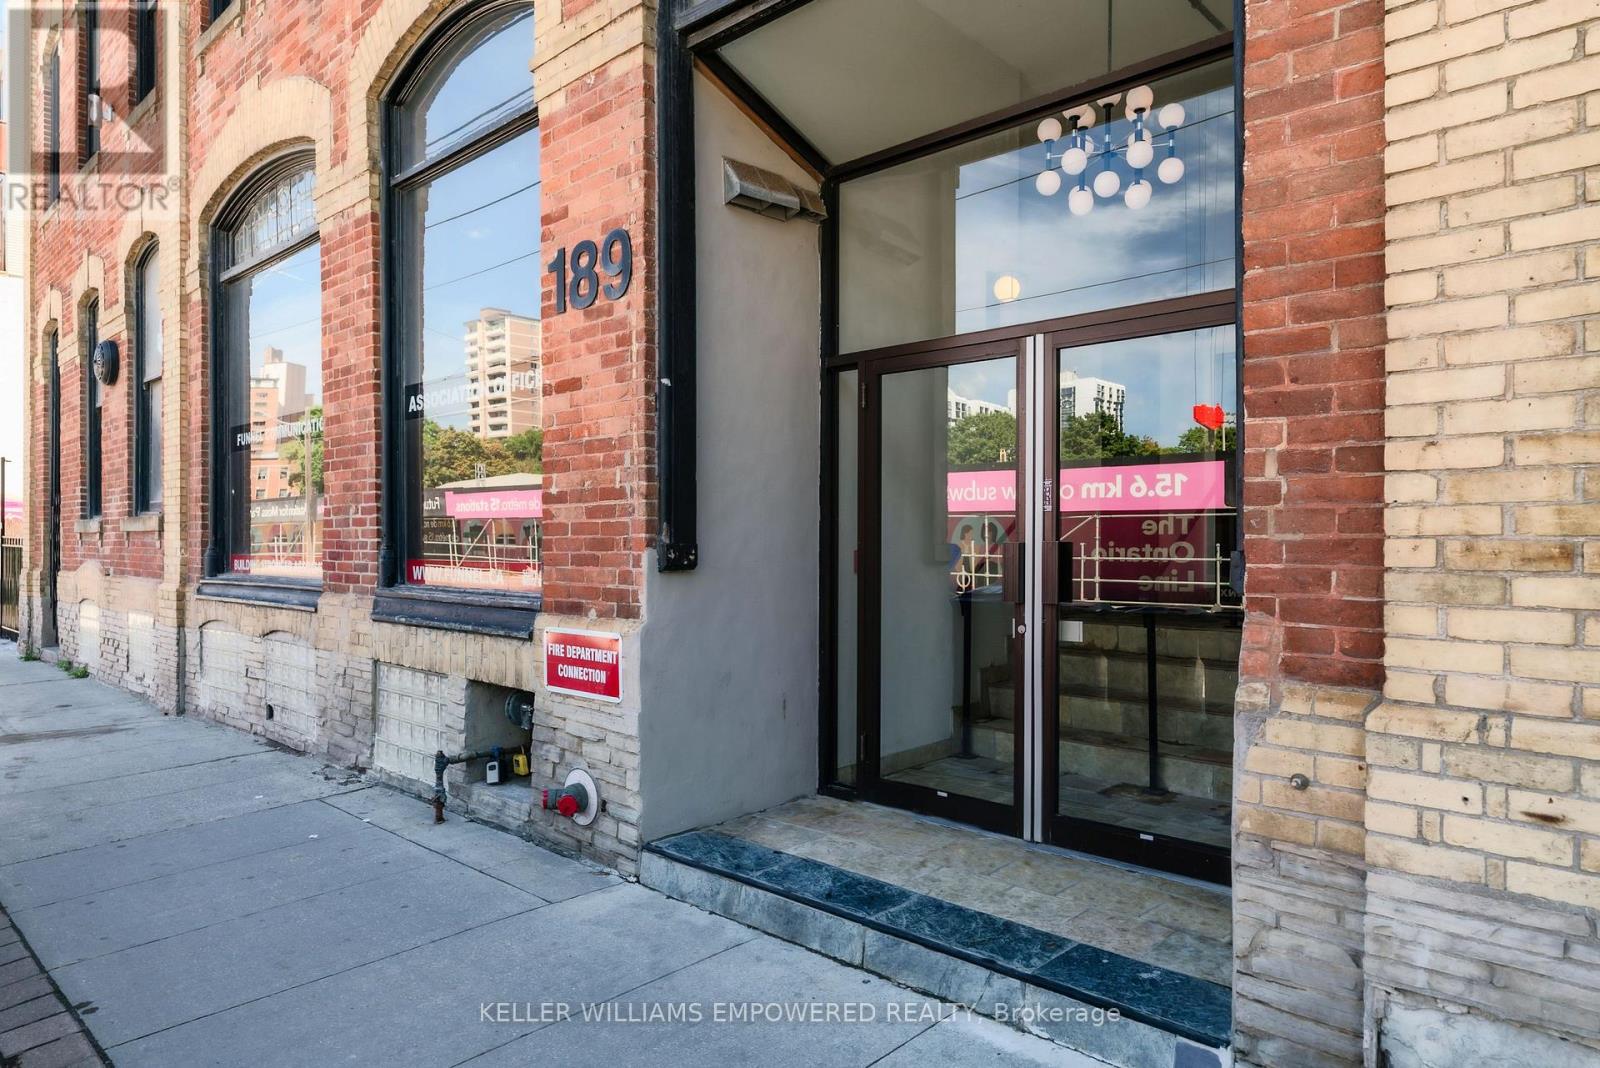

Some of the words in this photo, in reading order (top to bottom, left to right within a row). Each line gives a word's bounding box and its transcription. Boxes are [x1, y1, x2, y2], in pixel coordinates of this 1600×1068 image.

[548, 228, 632, 314] 189
[548, 643, 565, 657] FIRE
[566, 645, 618, 664] DEPARTMENT
[558, 664, 606, 683] CONNECTION
